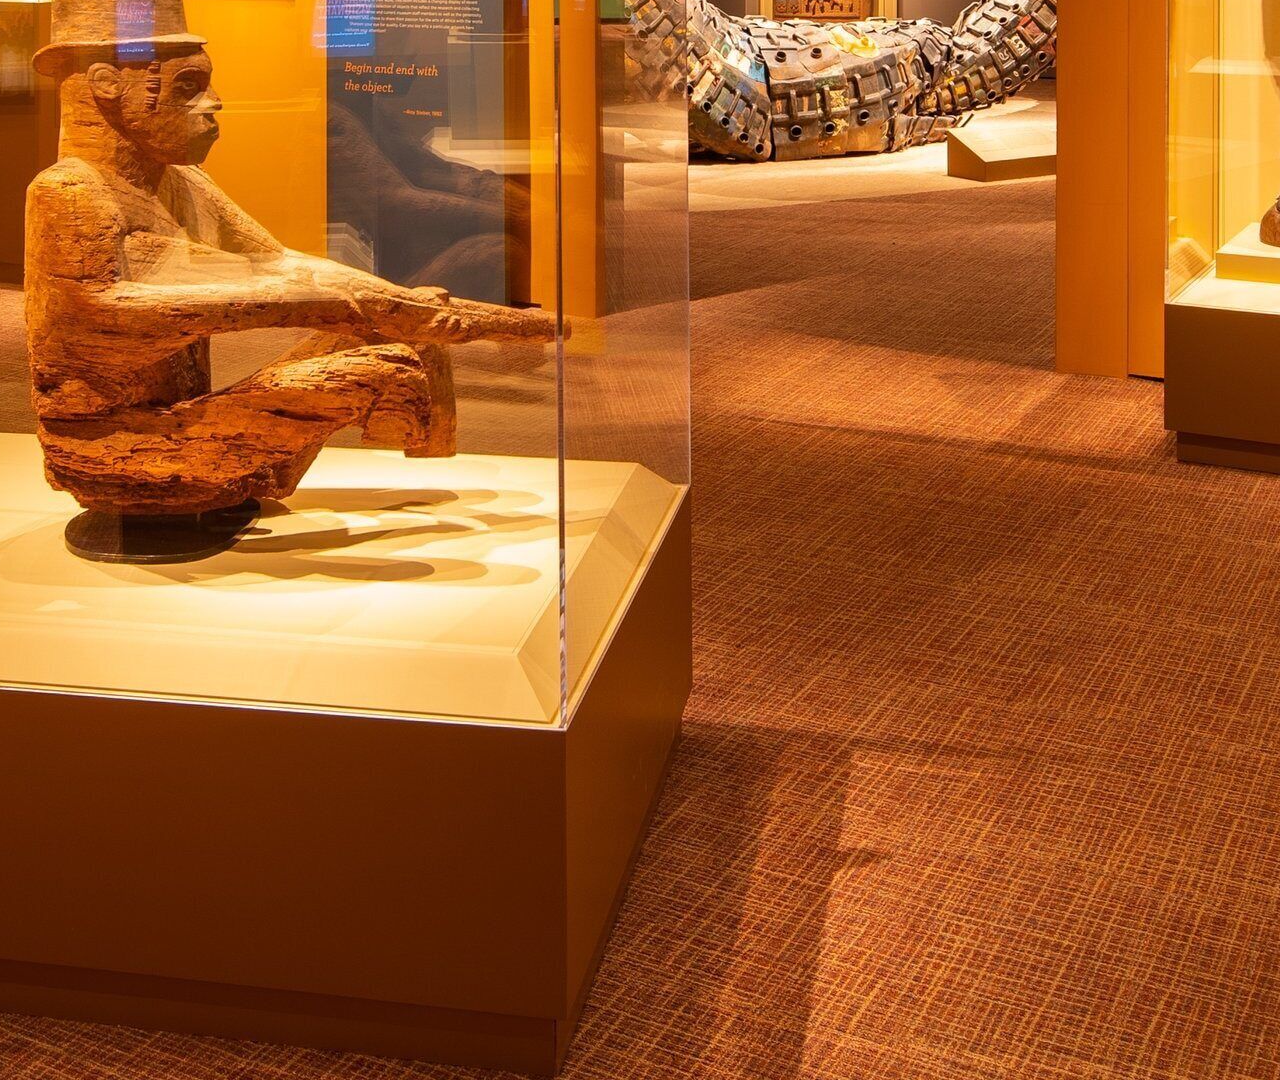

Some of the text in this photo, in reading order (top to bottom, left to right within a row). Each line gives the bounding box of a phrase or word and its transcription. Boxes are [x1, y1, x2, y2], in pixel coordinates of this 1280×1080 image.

[344, 62, 438, 76] Begin and end with
[344, 80, 394, 94] the object.
